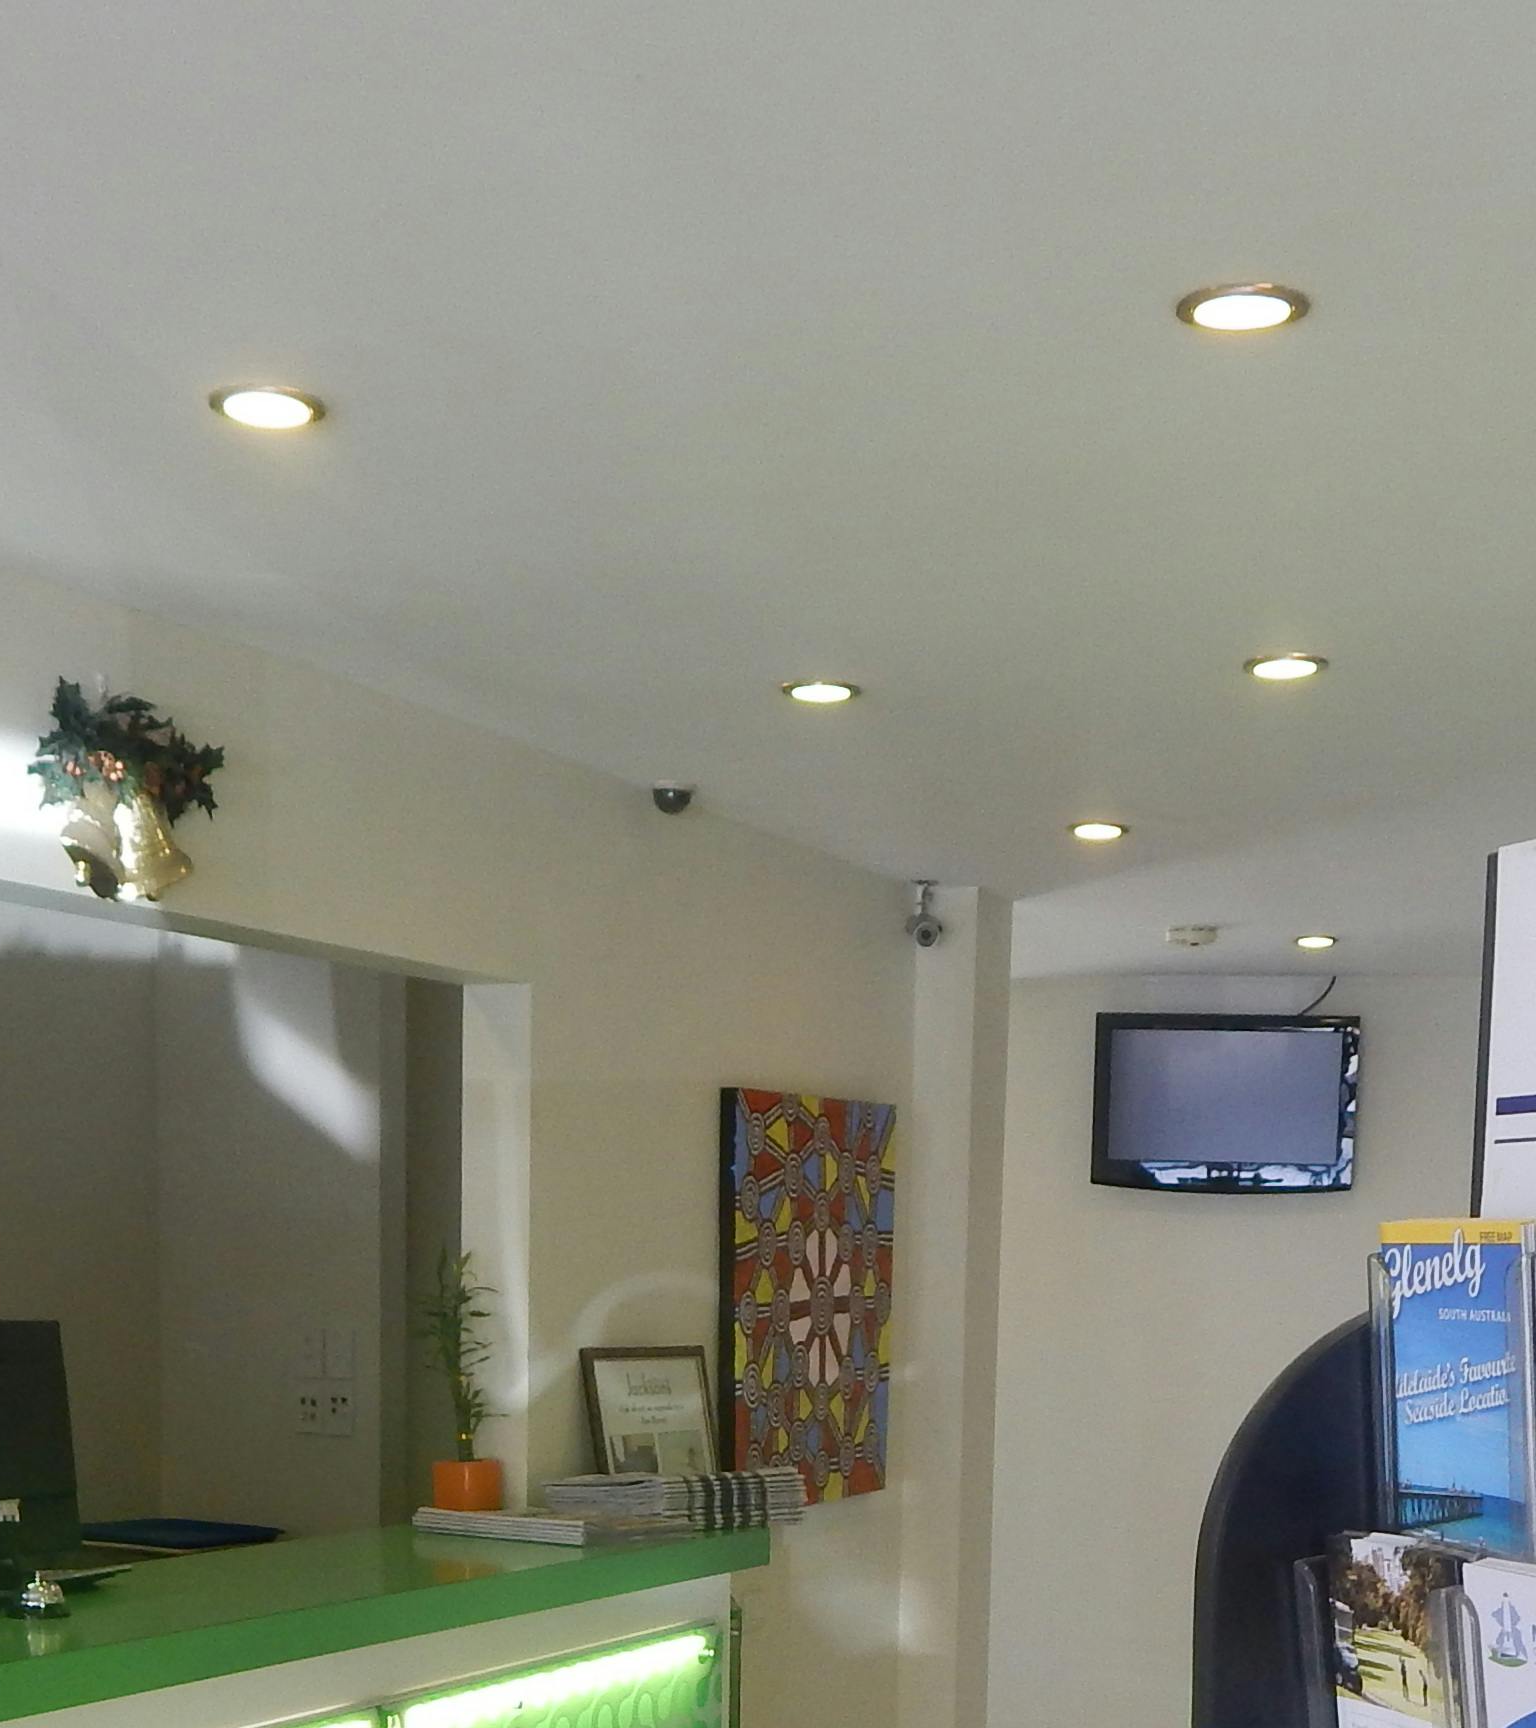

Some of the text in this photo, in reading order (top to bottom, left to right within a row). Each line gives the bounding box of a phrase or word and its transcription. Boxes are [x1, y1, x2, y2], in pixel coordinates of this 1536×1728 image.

[1480, 1232, 1513, 1242] FREE MAP
[1385, 1228, 1486, 1319] Glenelg
[1439, 1309, 1467, 1320] SOUTH
[1404, 1400, 1455, 1425] Seaside
